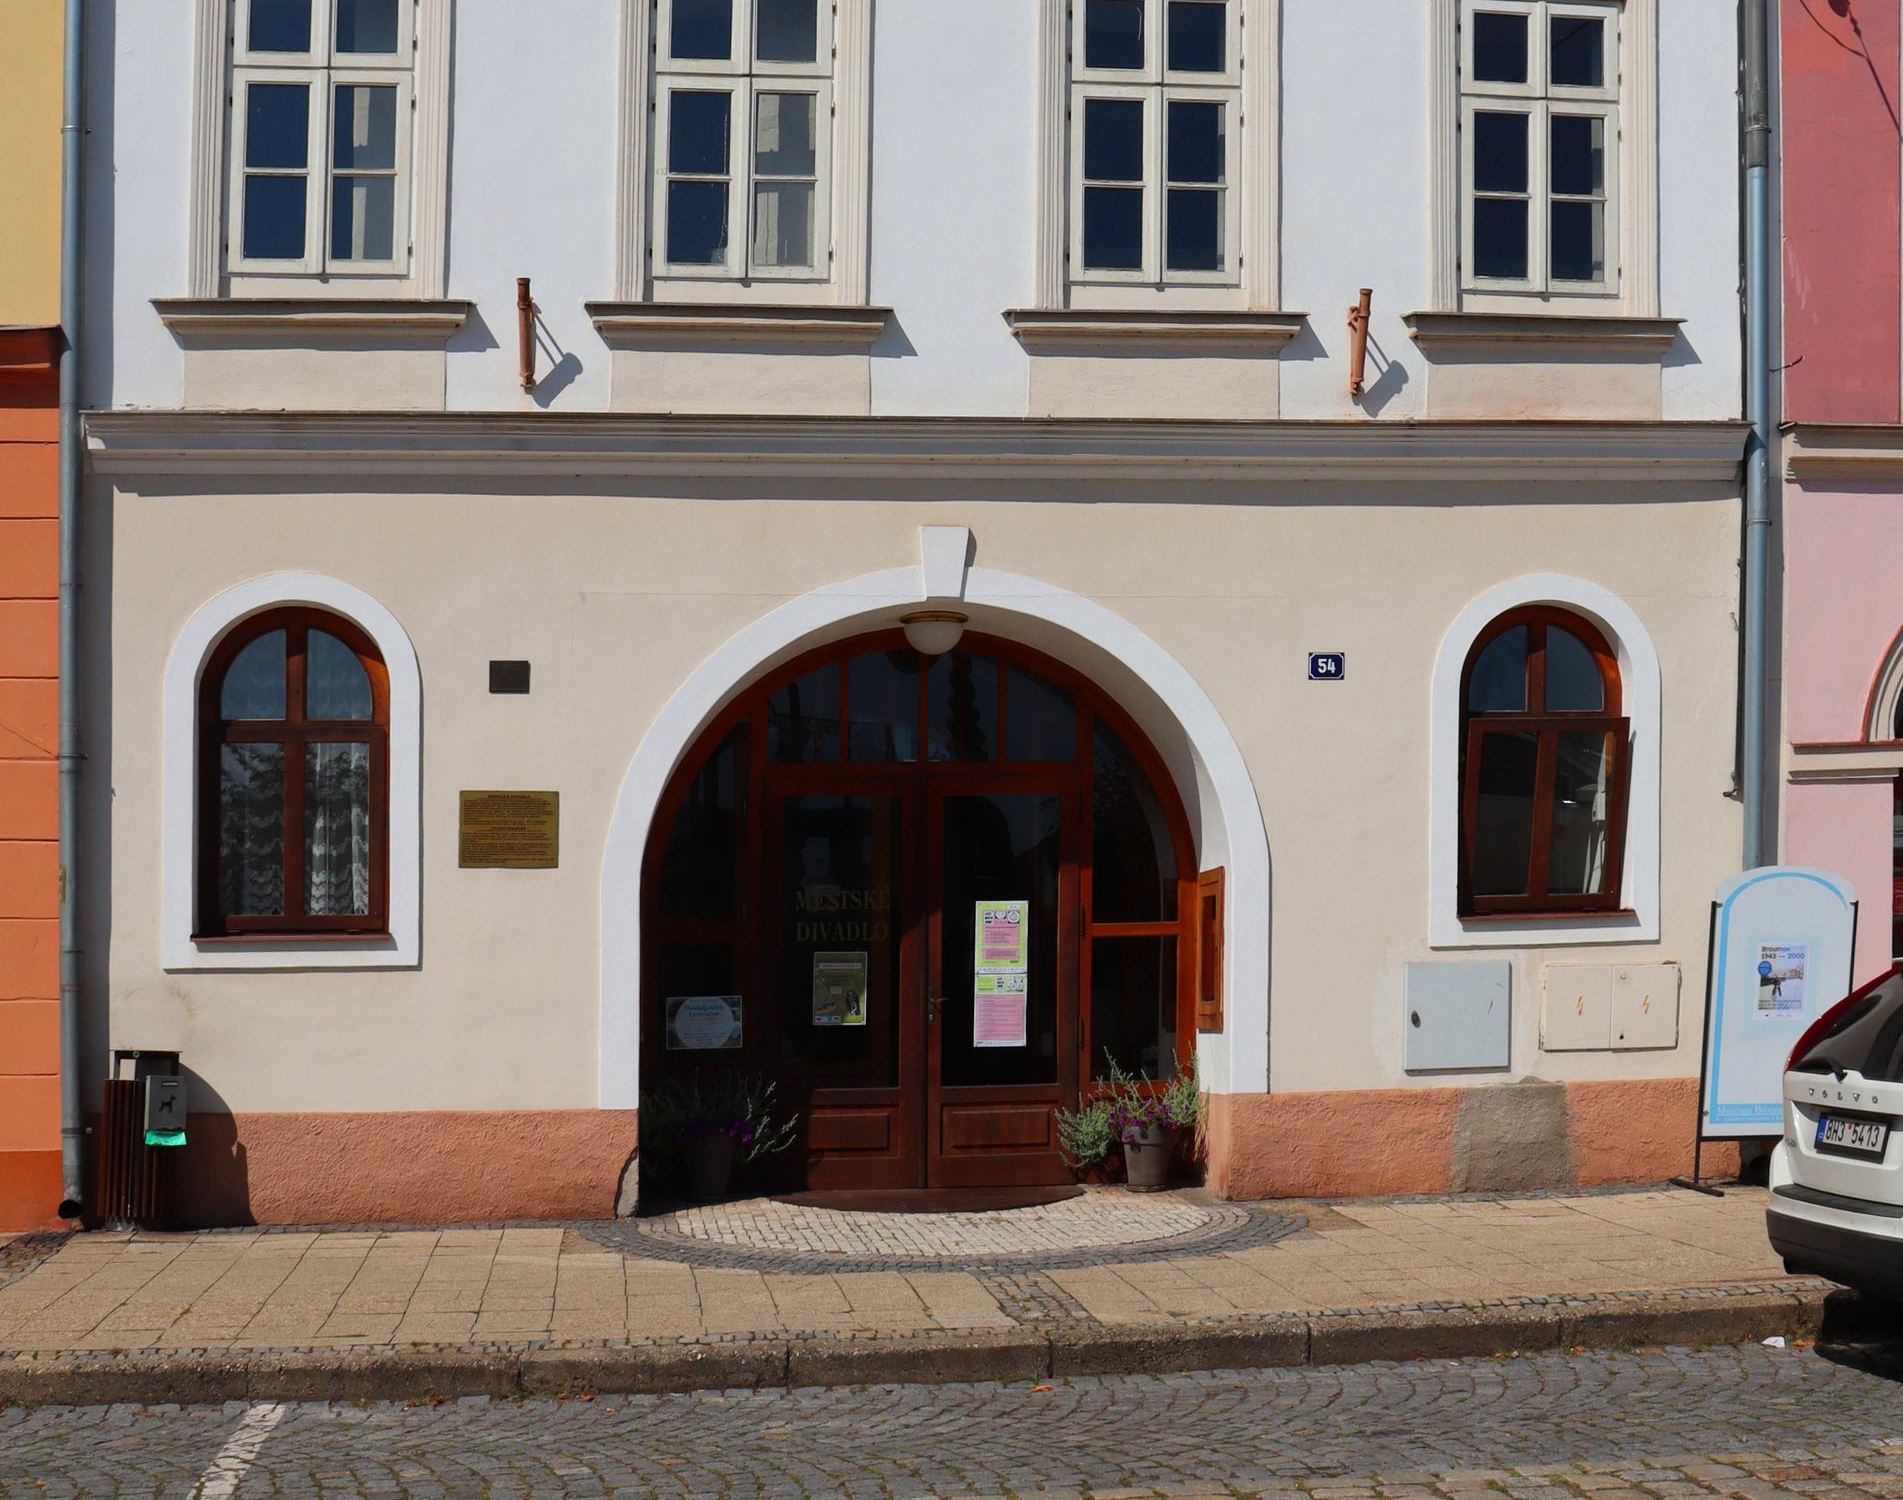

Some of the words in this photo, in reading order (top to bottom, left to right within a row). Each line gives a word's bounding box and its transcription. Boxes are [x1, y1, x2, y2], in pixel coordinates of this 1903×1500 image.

[1317, 658, 1336, 673] 54
[795, 922, 889, 941] DIVADLO
[1808, 1087, 1878, 1104] VOLVO
[1825, 1119, 1846, 1142] 8H3
[1851, 1124, 1880, 1148] 5413
